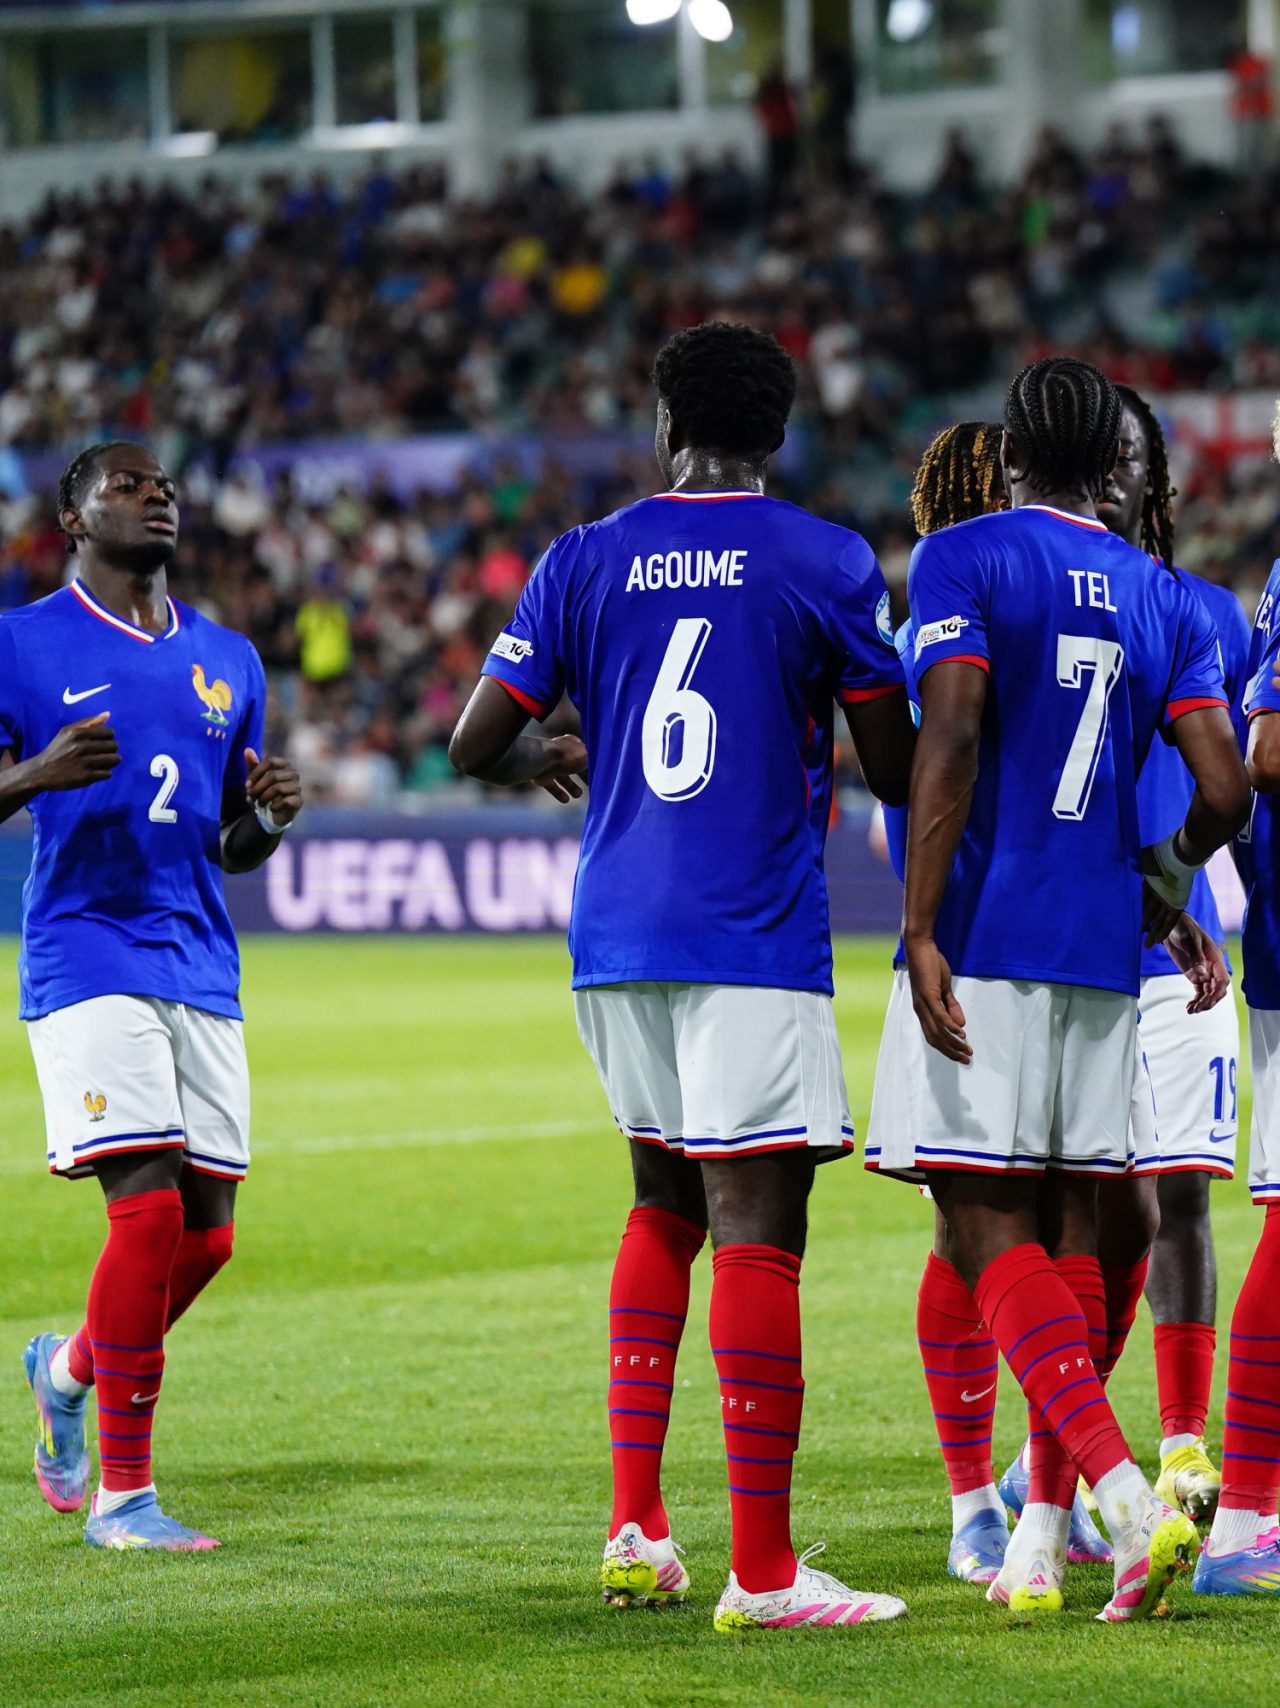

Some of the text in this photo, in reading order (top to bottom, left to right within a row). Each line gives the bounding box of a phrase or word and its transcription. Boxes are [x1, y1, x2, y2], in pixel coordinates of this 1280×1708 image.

[625, 550, 748, 592] AGOUME
[1068, 570, 1117, 612] TEL
[641, 617, 717, 802] 6
[1052, 634, 1125, 821] 7
[148, 754, 179, 823] 2
[267, 838, 465, 931] UEFA
